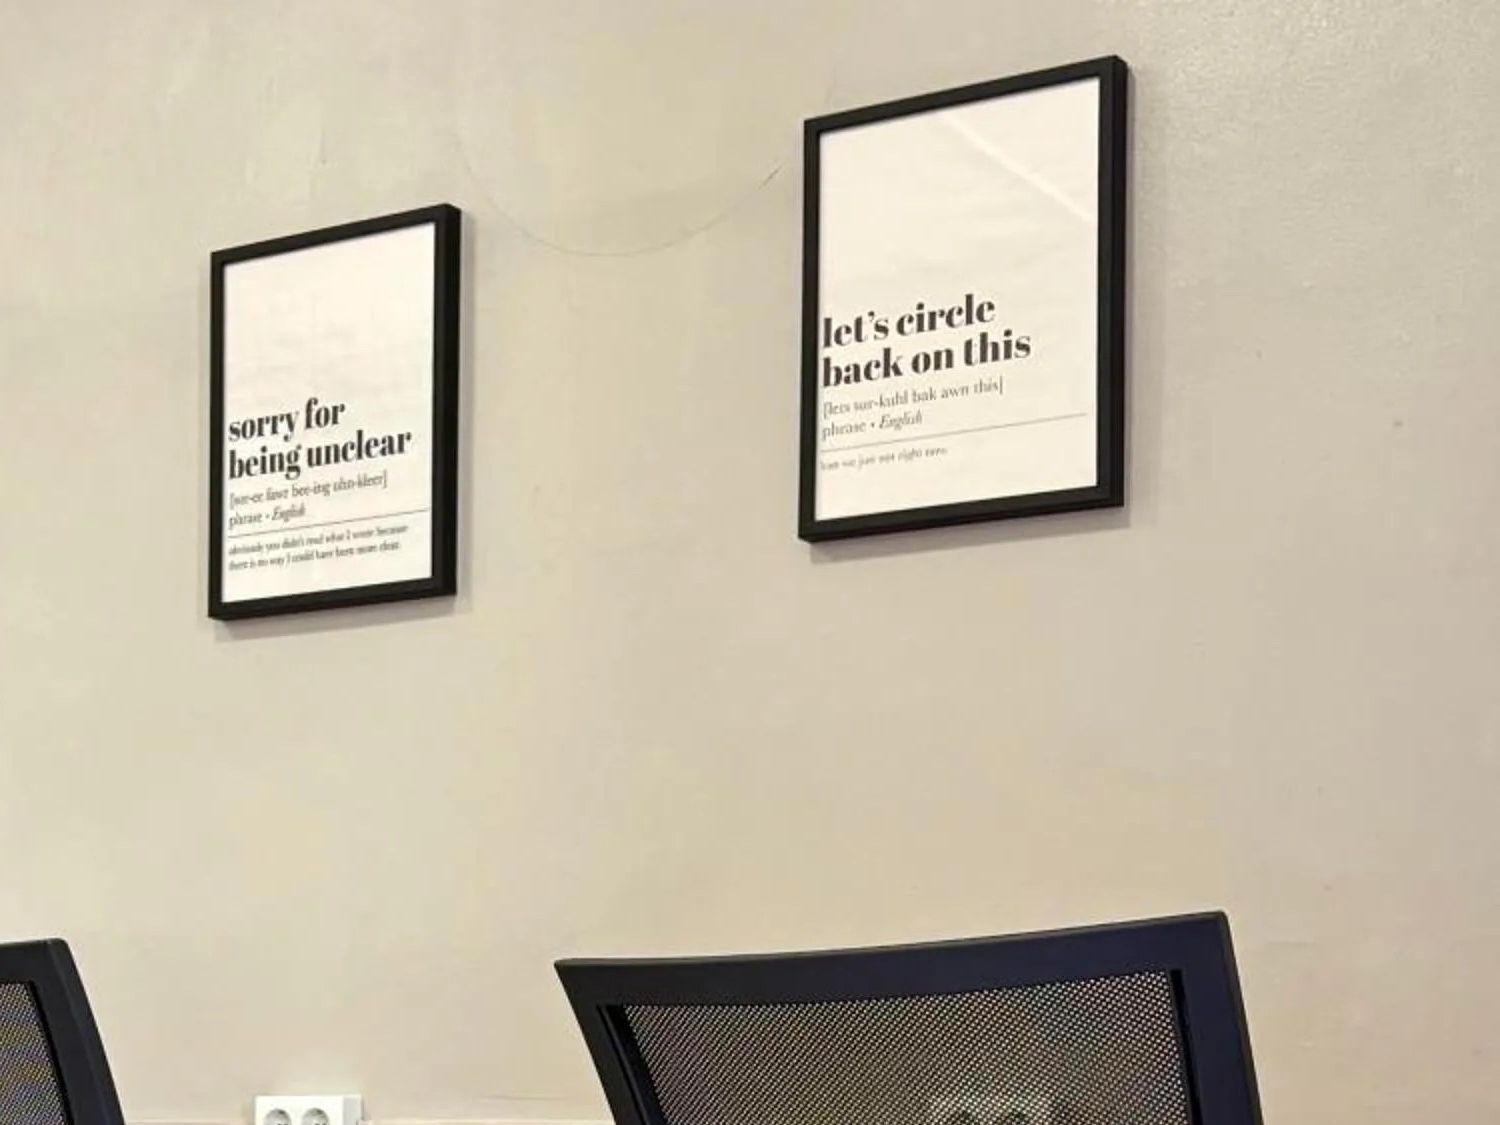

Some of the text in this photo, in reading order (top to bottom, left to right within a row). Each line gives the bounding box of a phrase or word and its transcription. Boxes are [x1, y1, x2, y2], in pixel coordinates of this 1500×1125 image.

[822, 293, 996, 348] let's circle
[822, 329, 1031, 388] back on this
[229, 397, 346, 442] sorry for
[229, 429, 412, 480] being unclear
